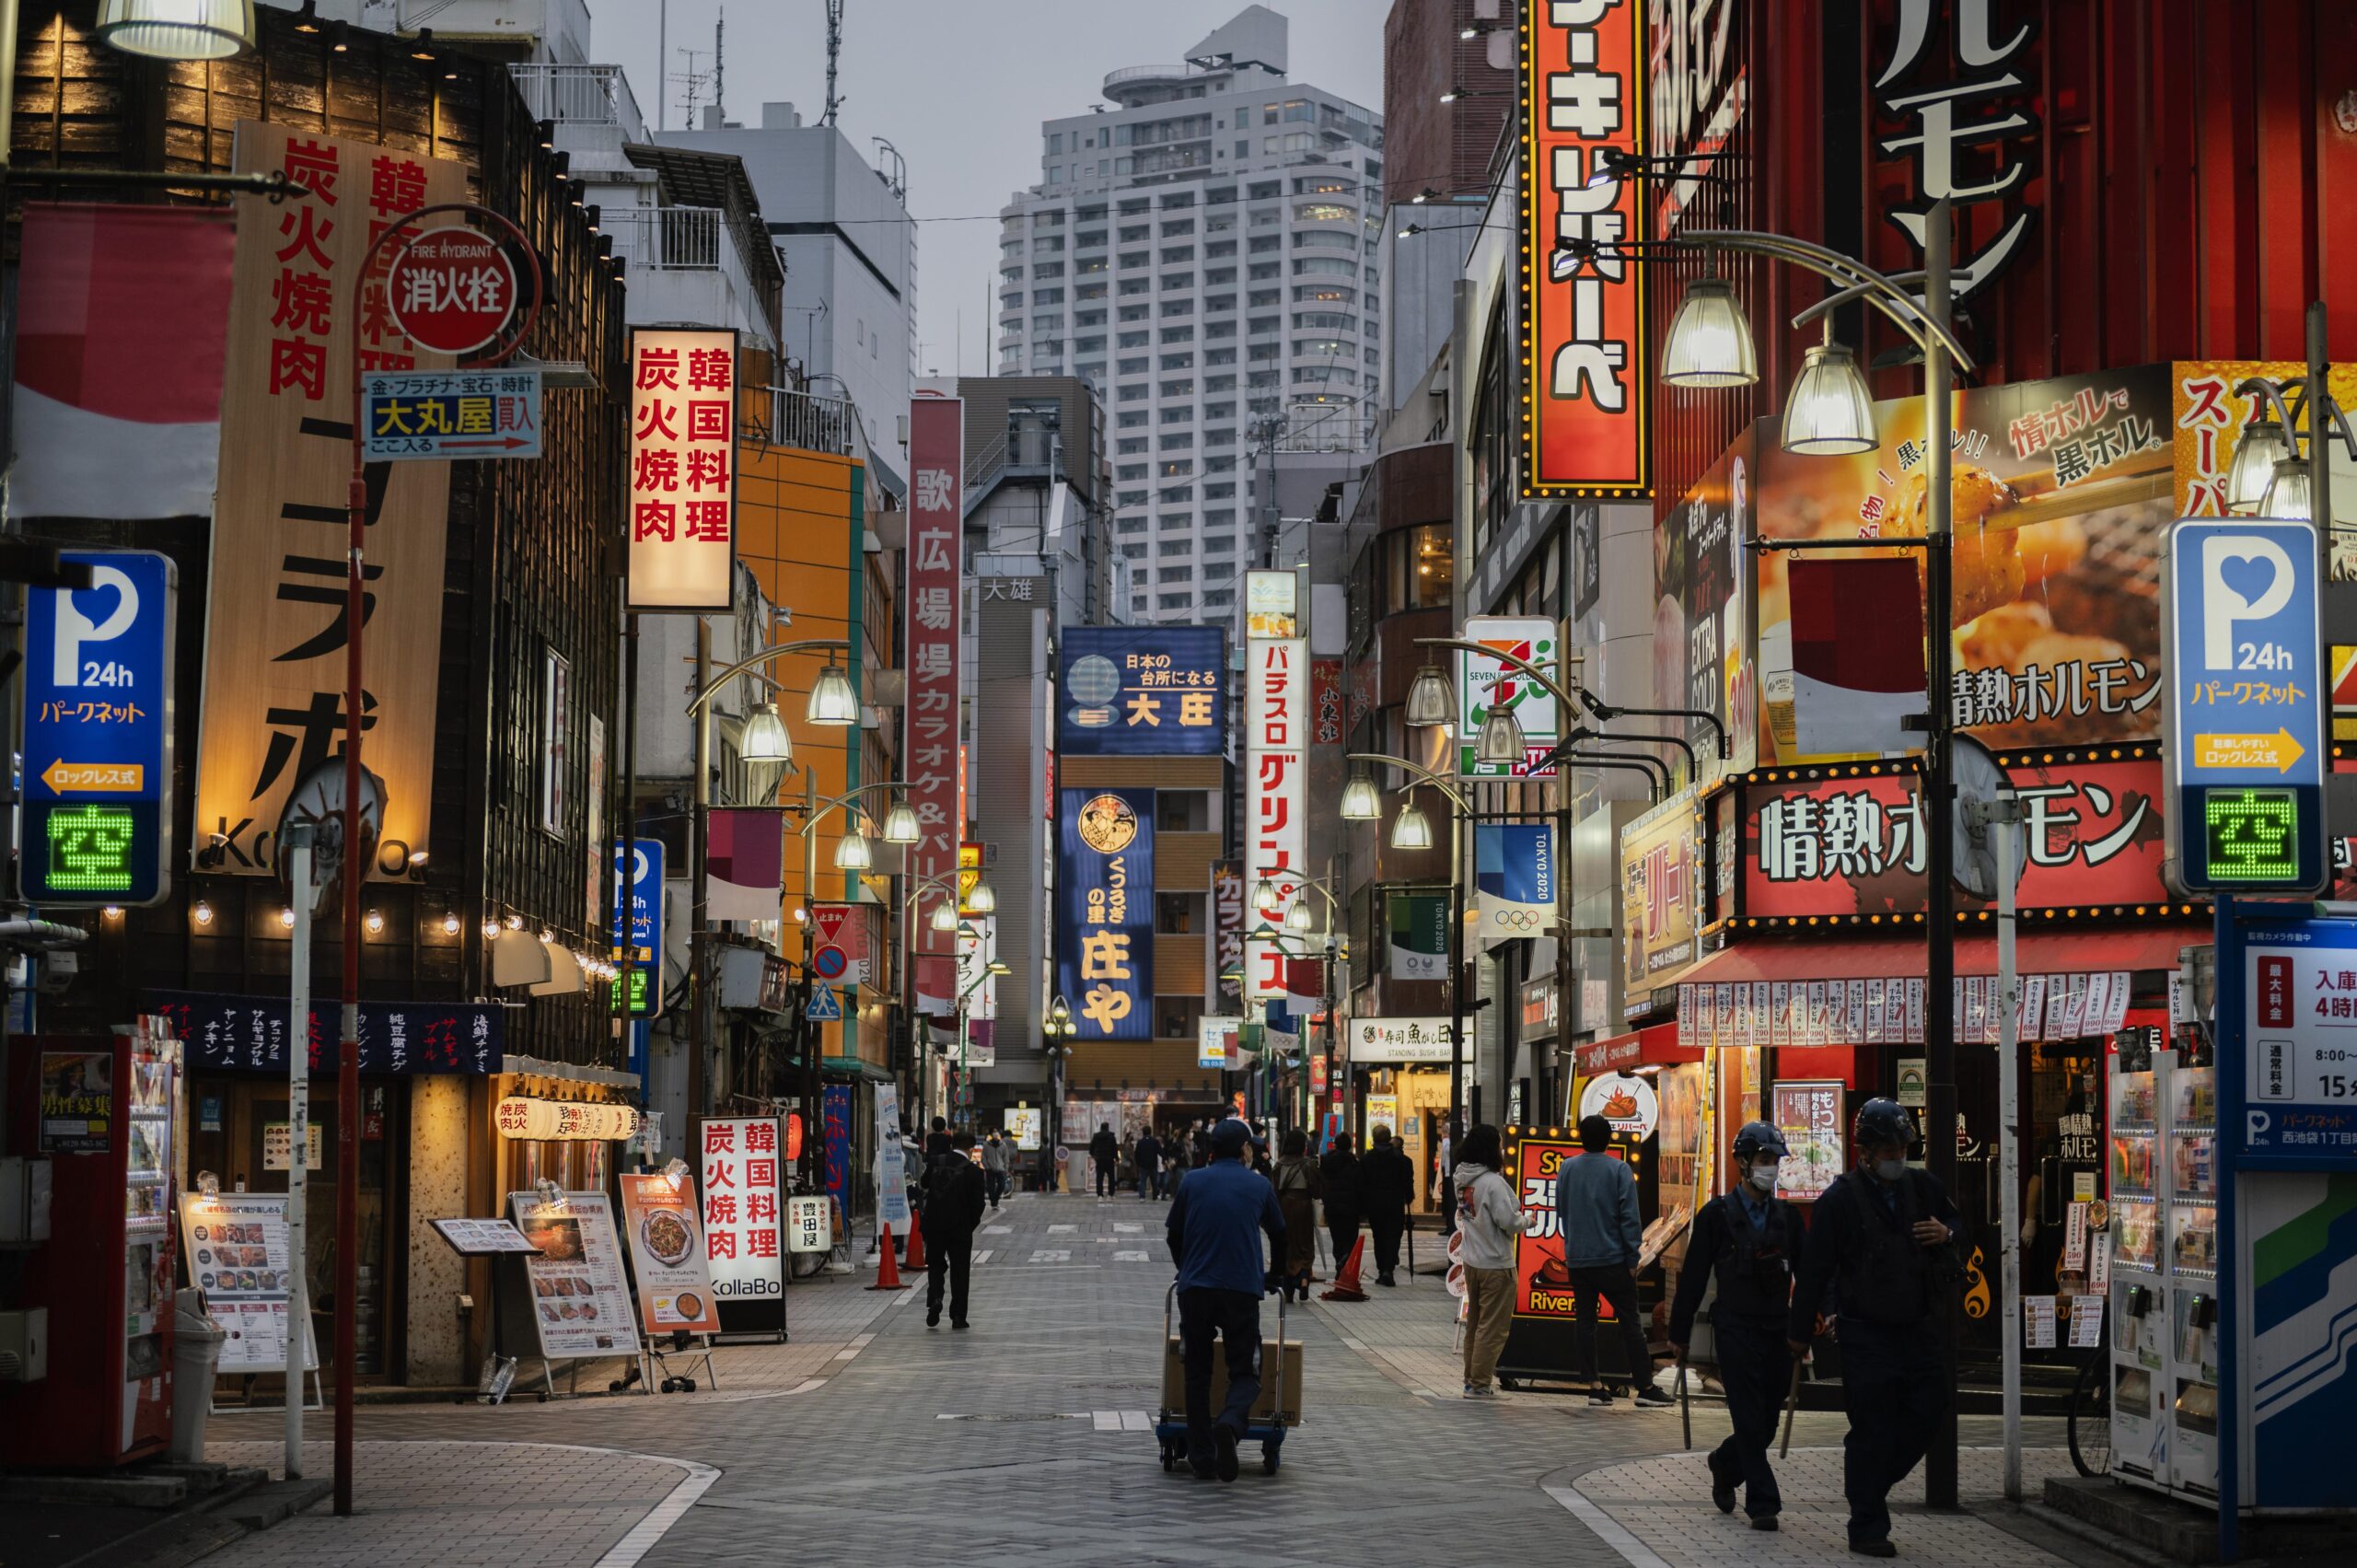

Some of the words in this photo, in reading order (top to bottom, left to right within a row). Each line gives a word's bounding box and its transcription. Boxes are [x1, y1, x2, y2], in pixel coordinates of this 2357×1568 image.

[411, 245, 436, 259] FIRE
[440, 238, 493, 259] HYDRANT
[268, 136, 340, 401] 炭火焼肉
[401, 266, 505, 314] 消火栓
[371, 376, 534, 396] 金・プラチナ・宝石・時計
[376, 397, 493, 436] 大丸屋
[498, 396, 534, 433] 買入
[2010, 387, 2130, 459] 情ホルで
[371, 438, 433, 453] ここ入る
[633, 347, 680, 543] 炭火焼肉
[684, 347, 733, 543] 韓国料理
[983, 577, 1033, 602] 大雄
[1690, 611, 1717, 677] EXTRA
[2237, 642, 2293, 671] 24h
[82, 660, 134, 689] 24h
[1126, 654, 1171, 669] 日本の
[1140, 670, 1215, 686] 台所になる
[1264, 645, 1289, 745] パチスロ
[1690, 665, 1717, 728] COLD
[2190, 680, 2306, 707] パークネット
[39, 701, 145, 726] パークネット
[1126, 692, 1213, 727] 大庄
[2205, 750, 2279, 764] ロックレス式
[2213, 738, 2270, 749] 駐車しやすい
[53, 768, 137, 787] ロックレス式
[1760, 782, 2151, 880] 情熱ホモン
[2206, 789, 2298, 879] 空
[46, 804, 134, 890] 空
[1536, 833, 1548, 871] TOKYO
[1259, 754, 1297, 992] グリンピス
[1537, 872, 1549, 900] 2020
[1108, 856, 1126, 924] くつろぎ
[819, 912, 844, 923] 止まれ
[1435, 901, 1444, 931] TOKYO
[1435, 931, 1444, 952] 2020
[1080, 929, 1132, 1035] 庄や
[2269, 963, 2282, 1021] 最大料金
[2315, 997, 2357, 1019] 4時
[204, 1020, 221, 1054] チキン
[221, 1008, 237, 1065] ヤンニョム
[1887, 1027, 1902, 1035] 990
[2047, 1024, 2061, 1032] 790
[2063, 1021, 2079, 1030] 990
[2084, 1019, 2101, 1028] 990
[389, 1013, 407, 1072] 純豆腐チゲ
[471, 1014, 490, 1073] 海鮮チヂミ
[1387, 1049, 1416, 1057] STANDING
[1419, 1049, 1436, 1057] SUSHI
[1439, 1049, 1451, 1057] BAR
[2269, 1044, 2282, 1097] 通常料金
[500, 1104, 513, 1131] 焼肉
[514, 1103, 528, 1130] 炭火
[1819, 1091, 1835, 1144] もつ鍋
[704, 1122, 737, 1260] 炭火焼肉
[744, 1121, 779, 1259] 韓国料理
[802, 1202, 819, 1247] 豊田屋
[2066, 1251, 2082, 1260] 590
[709, 1277, 781, 1296] KollaBo
[2091, 1281, 2106, 1289] 690
